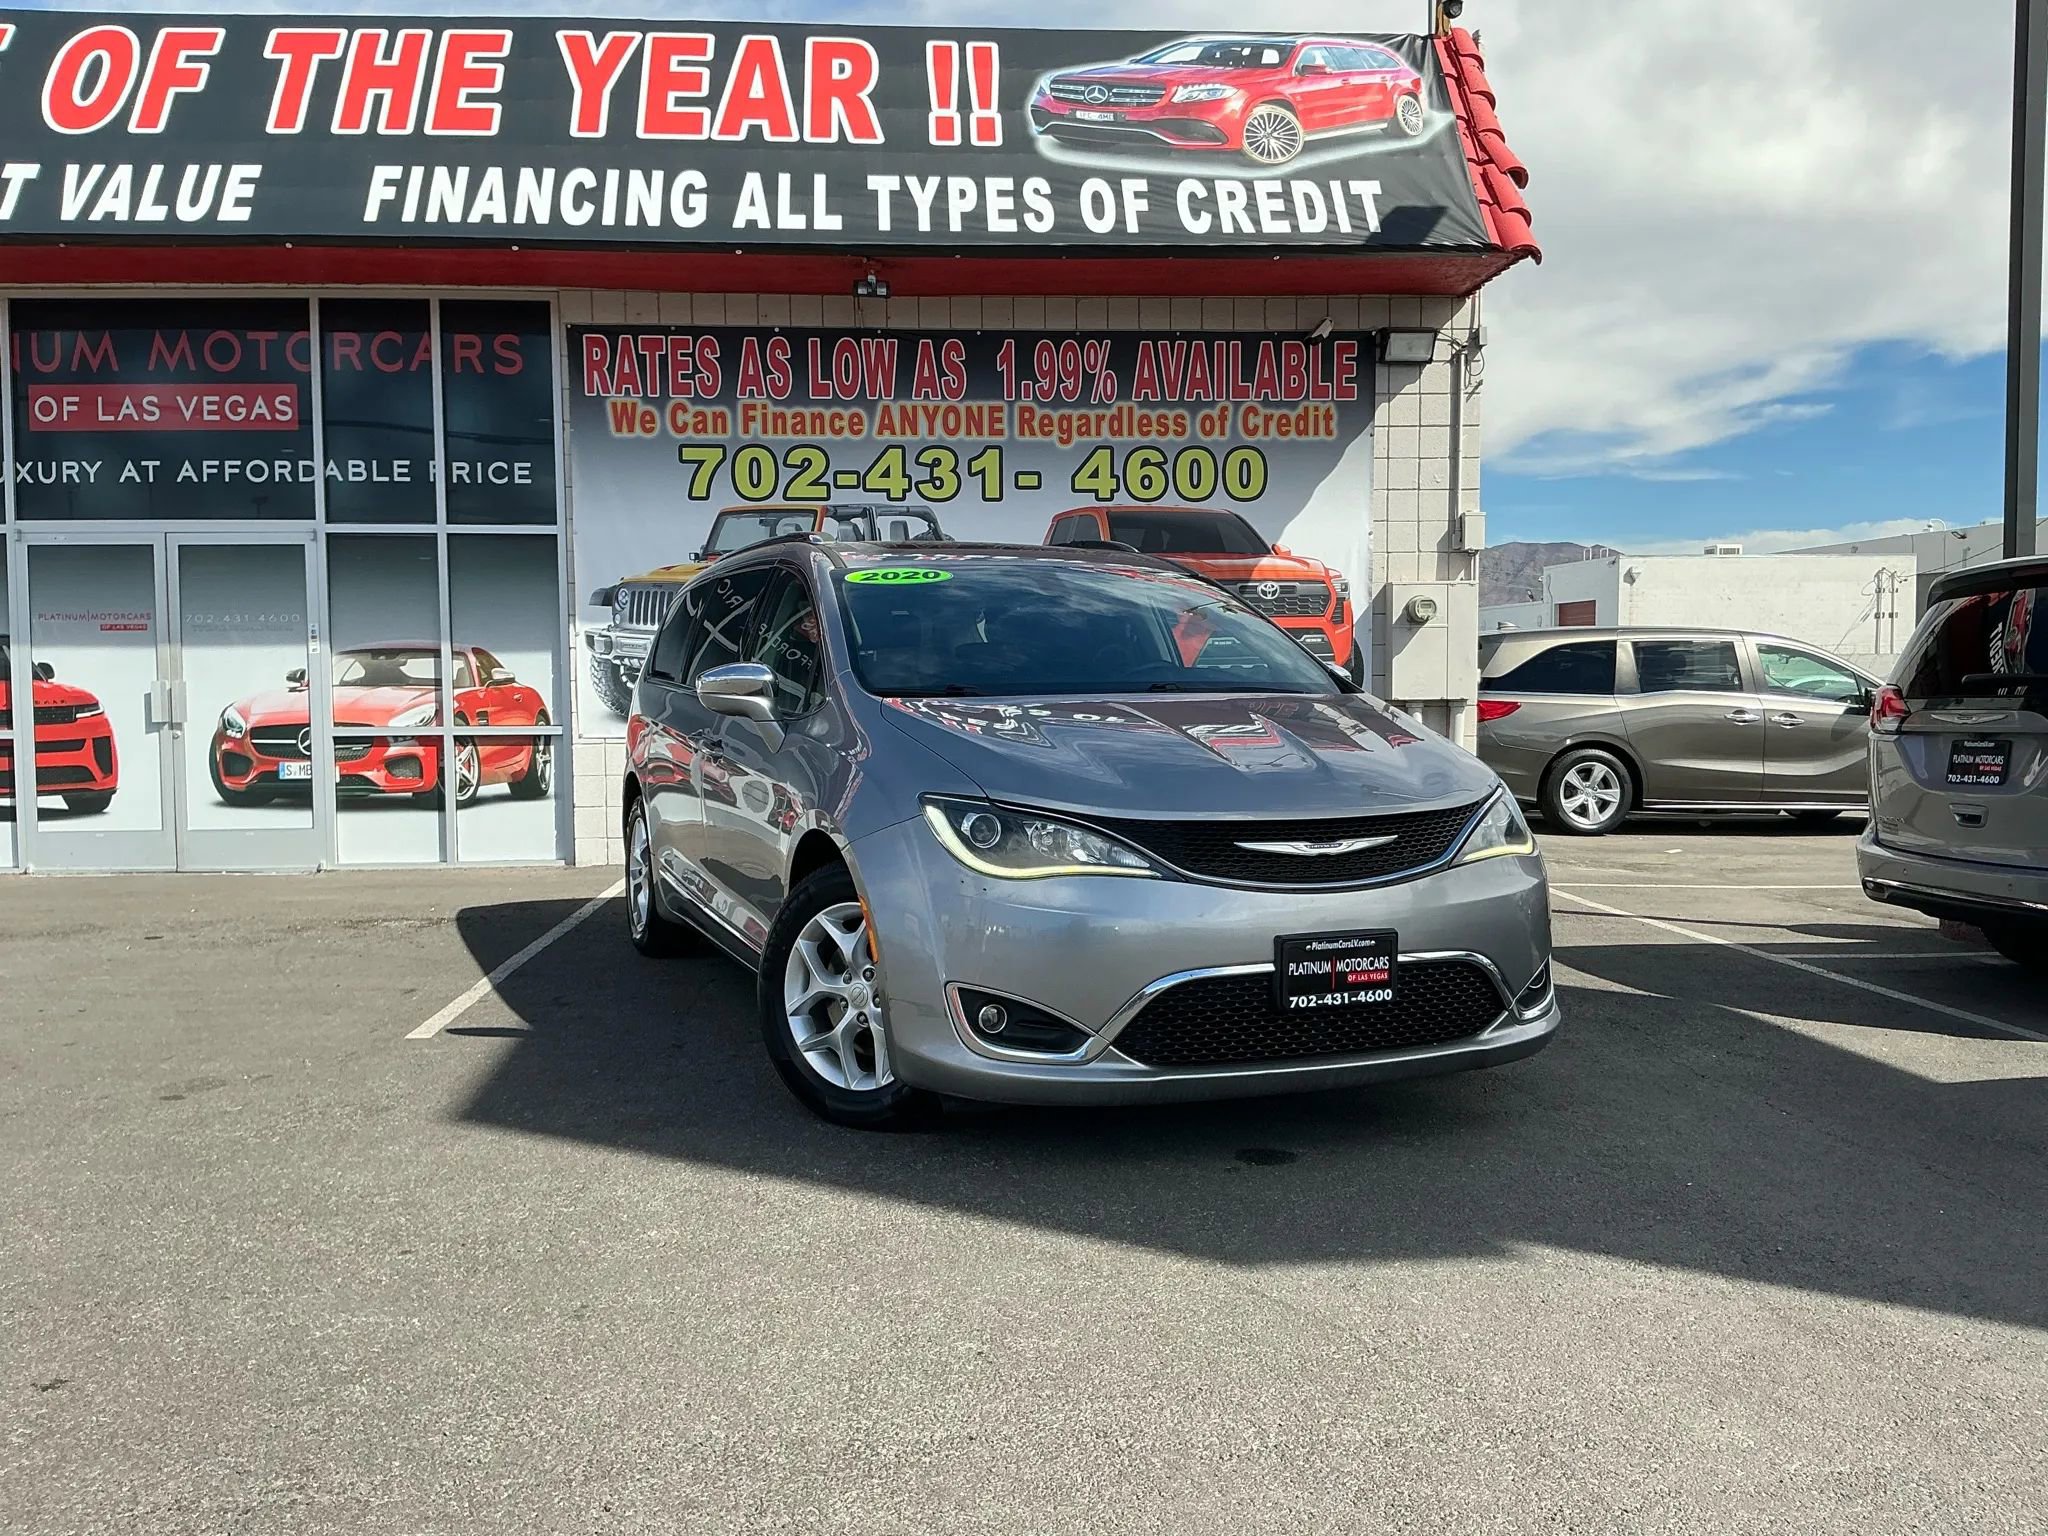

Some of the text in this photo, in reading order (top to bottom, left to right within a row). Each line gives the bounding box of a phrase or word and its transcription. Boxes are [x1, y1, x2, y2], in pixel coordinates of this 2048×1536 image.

[42, 25, 1003, 147] OF THE YEAR !!
[60, 164, 262, 221] VALUE
[364, 166, 708, 228] FINANCING
[732, 172, 843, 230] ALL
[867, 175, 1054, 233] TYPES
[1079, 178, 1151, 234] OF
[1176, 179, 1383, 235] CREDIT
[148, 330, 523, 376] MOTORCARS
[582, 334, 1358, 403] RATES AS LOW AS 1.99% AVAILABLE
[34, 395, 293, 422] OF LAS VEGAS
[610, 402, 1334, 446] We Can Finance ANYONE Regardless of Credit
[119, 460, 161, 483] AT
[176, 459, 411, 484] AFFORDABLE
[1071, 446, 1268, 502] 4600
[860, 571, 941, 581] 2020
[38, 612, 152, 621] PLATINUM MOTORCARS
[1948, 774, 2000, 784] 702-431-4600
[1289, 956, 1389, 976] PLATINUM MOTORCARS
[1370, 972, 1388, 980] VEGAS
[1289, 989, 1393, 1009] 702-431-4600
